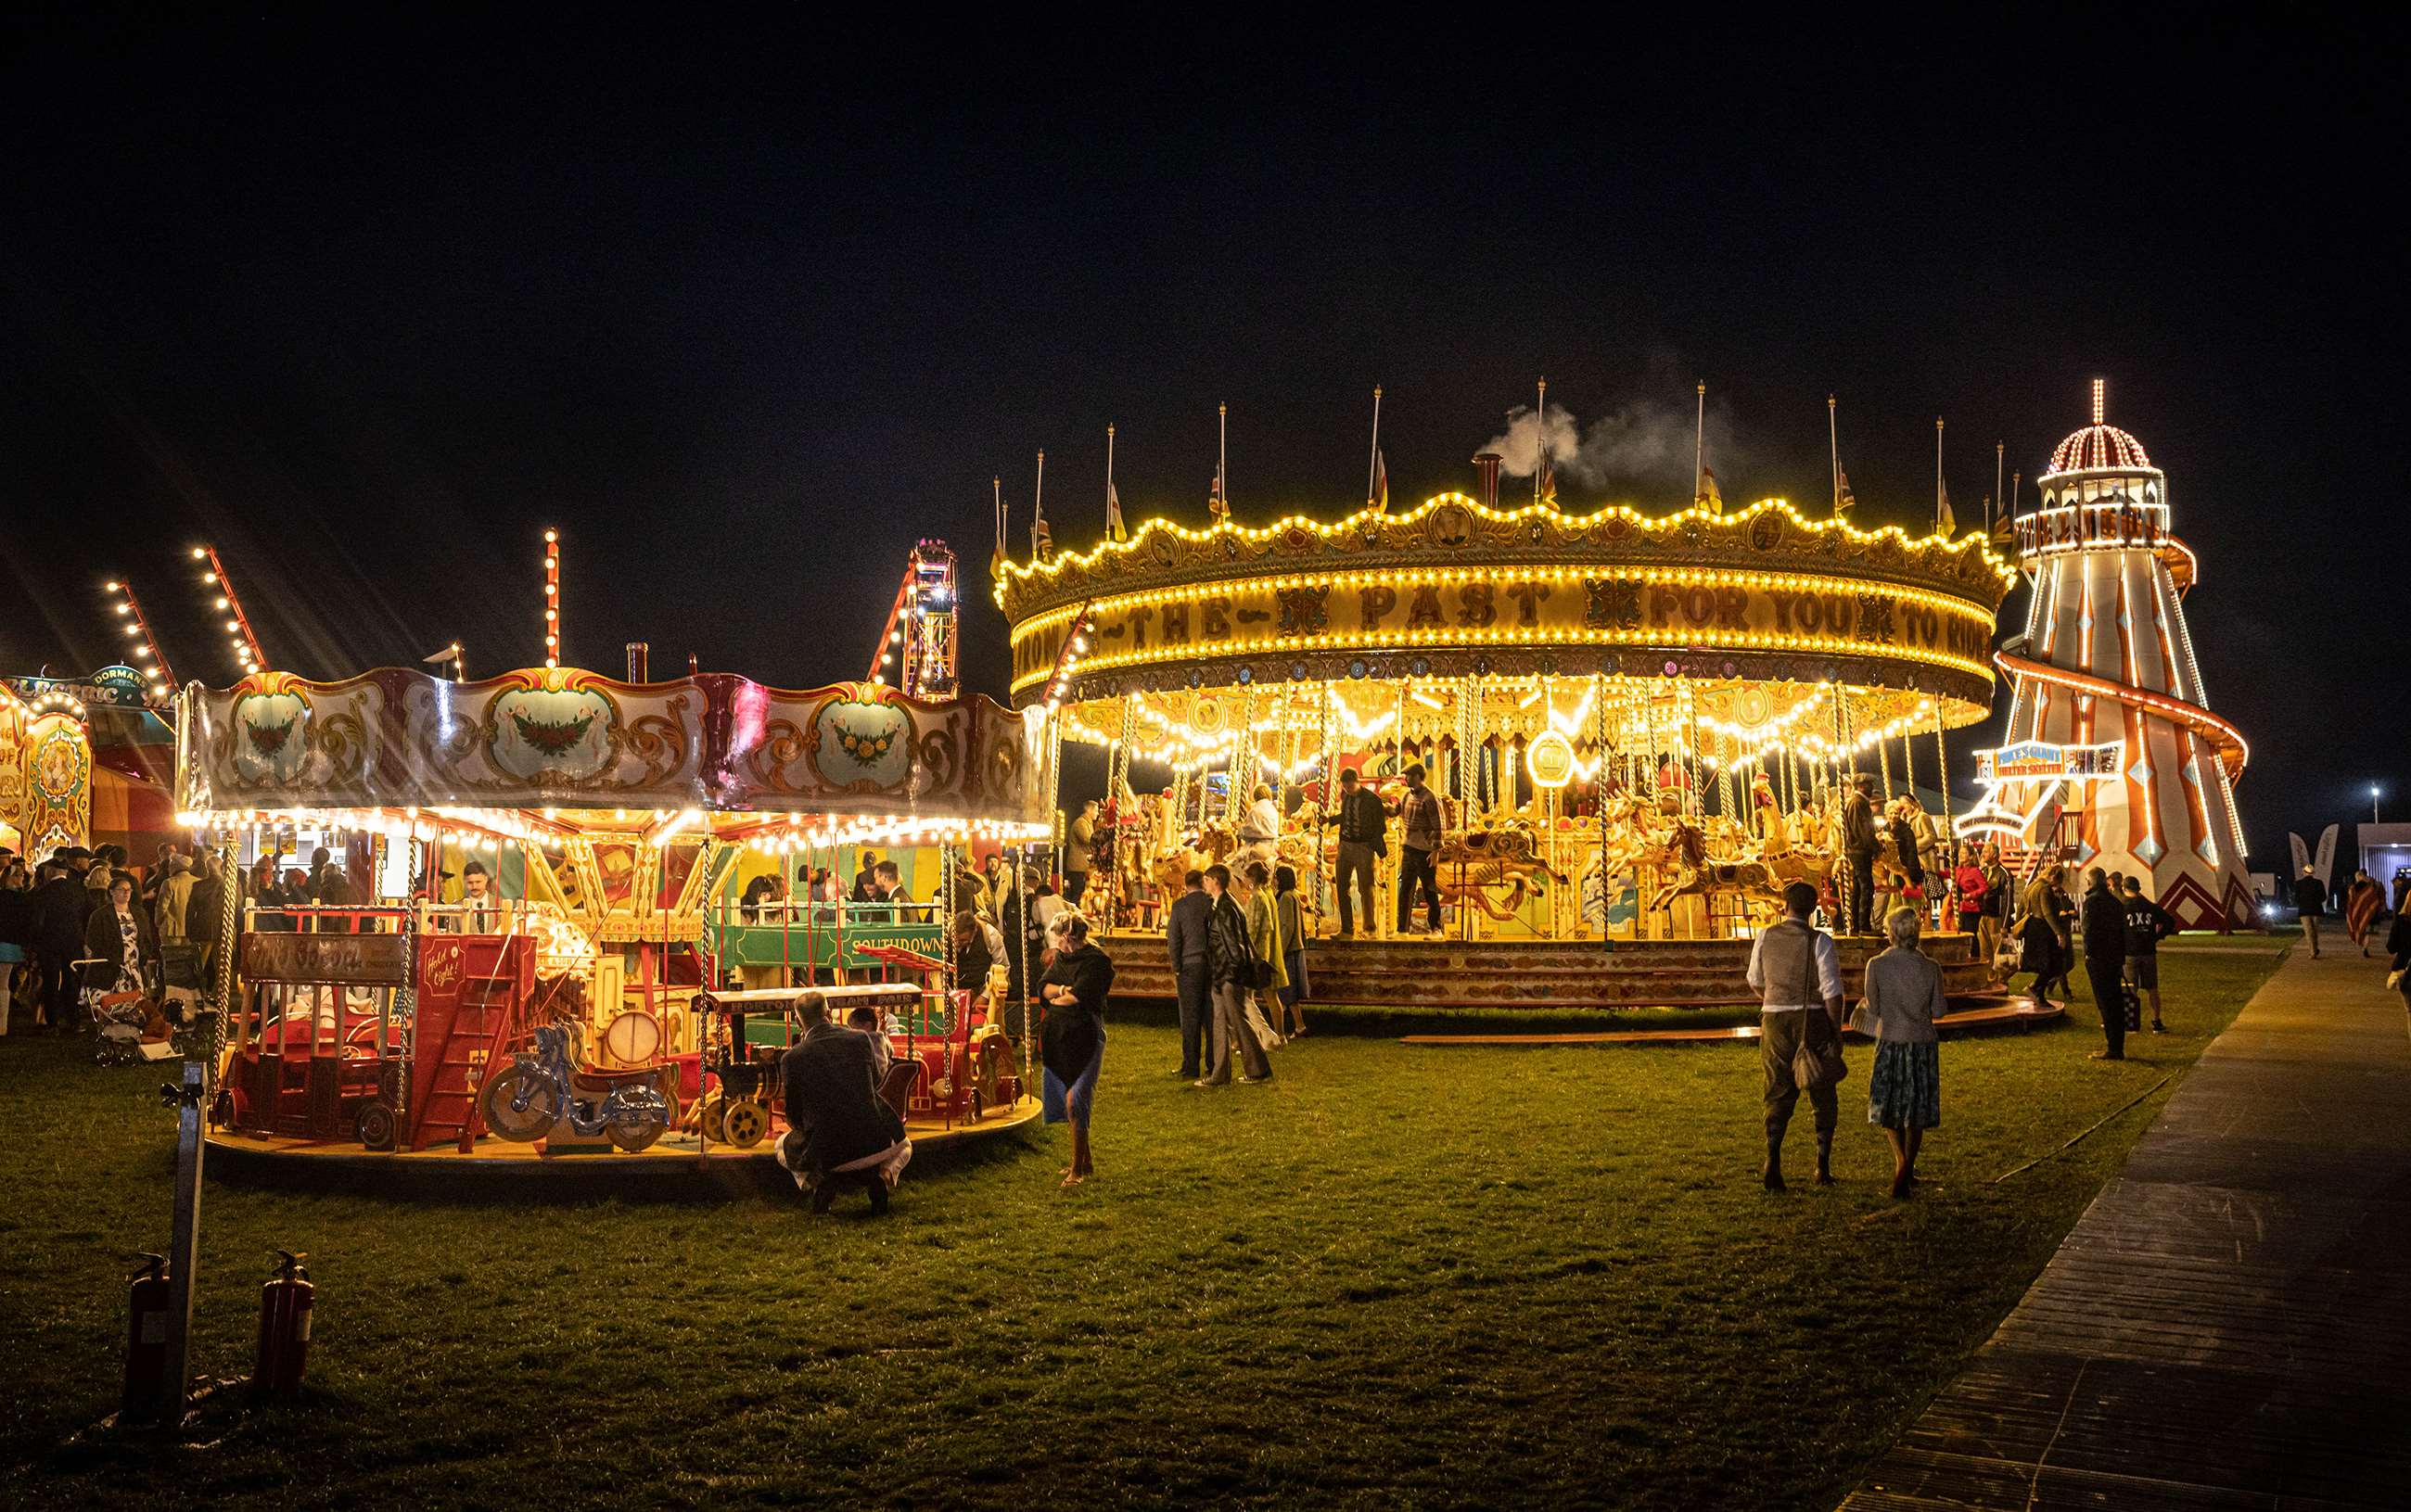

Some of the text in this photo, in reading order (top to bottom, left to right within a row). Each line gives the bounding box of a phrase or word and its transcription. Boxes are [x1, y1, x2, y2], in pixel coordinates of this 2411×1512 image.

[1359, 582, 1550, 631] PAST
[1647, 585, 1751, 631] FOR
[1765, 591, 1855, 638] YOU
[1900, 604, 1938, 648] TO
[1998, 766, 2027, 777] HELTER
[2028, 763, 2061, 776] SKELTER
[852, 937, 944, 955] SOUTHDOWN
[731, 999, 795, 1011] HORTON
[828, 996, 870, 1009] TEAM
